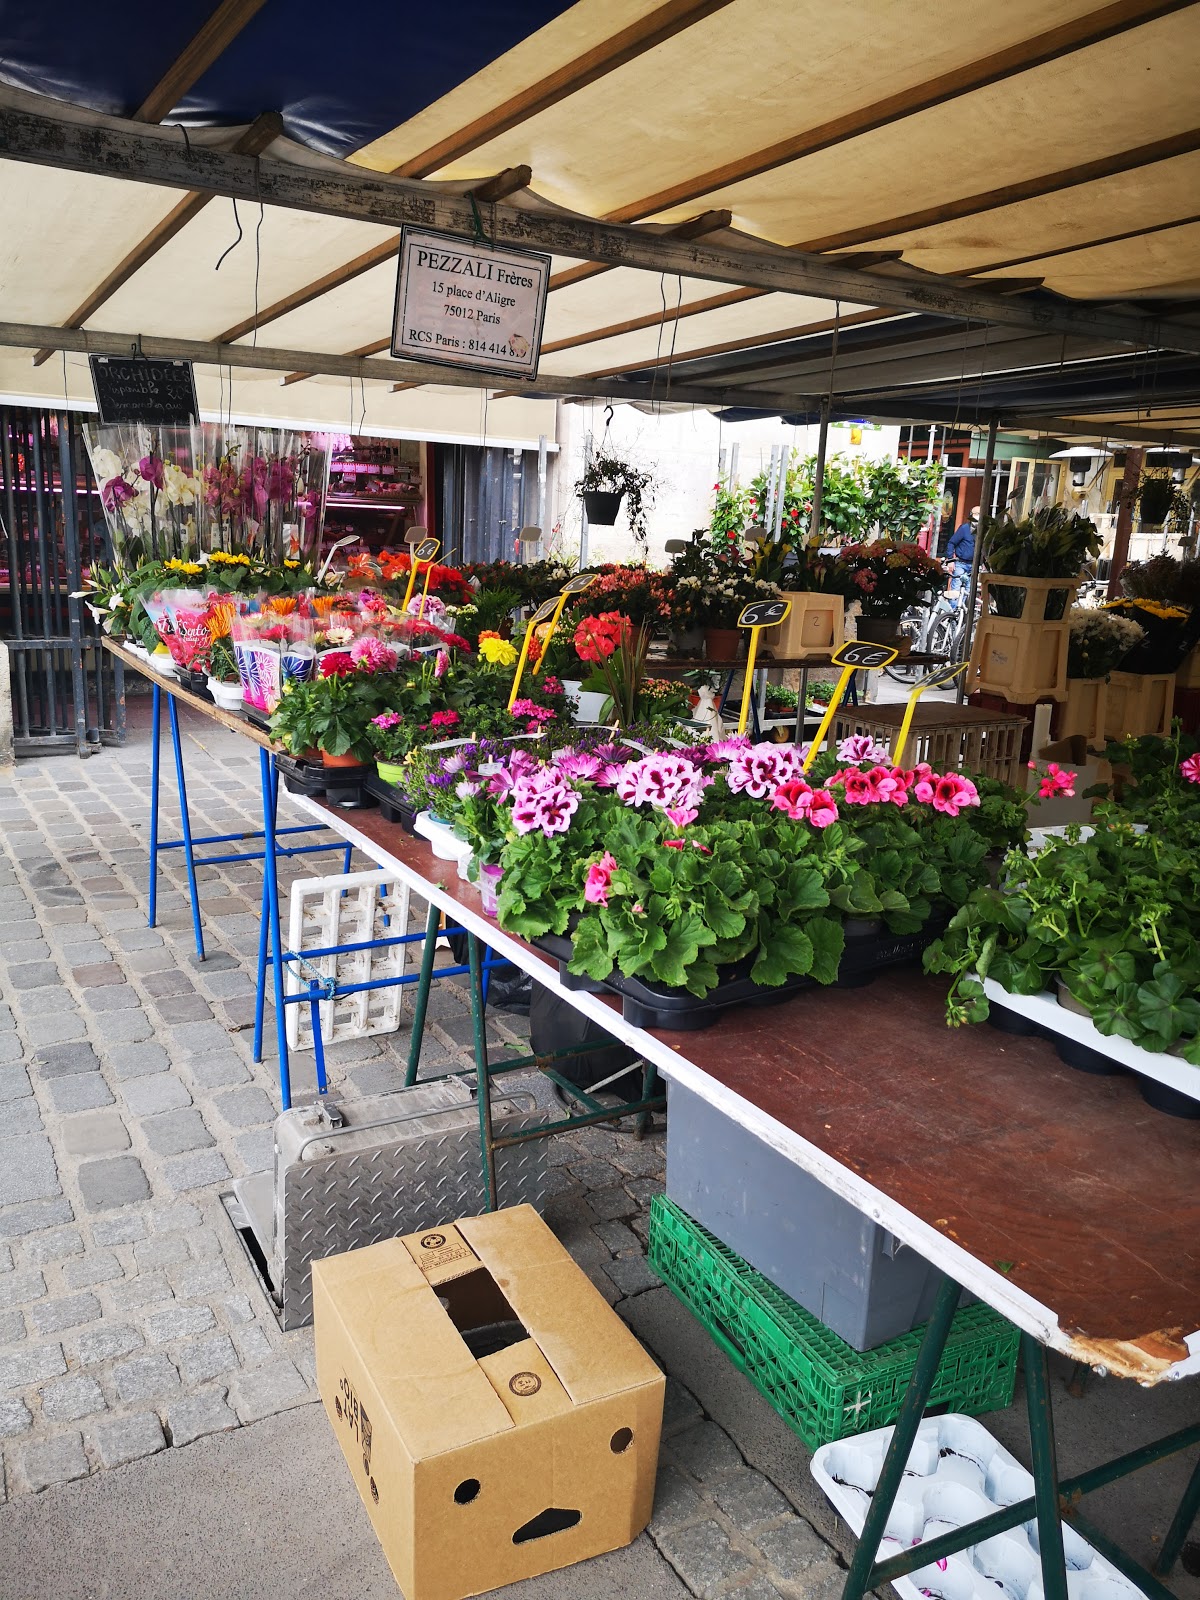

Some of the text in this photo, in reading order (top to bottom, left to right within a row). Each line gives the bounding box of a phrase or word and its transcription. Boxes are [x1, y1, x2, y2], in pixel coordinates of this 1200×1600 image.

[416, 250, 533, 288] PEZZALI Frères
[432, 281, 516, 308] 15 place d'Aligre
[443, 304, 501, 325] 75012 Paris
[408, 329, 432, 342] RCS
[435, 334, 460, 348] Paris
[468, 338, 486, 351] 814
[489, 342, 507, 355] 414
